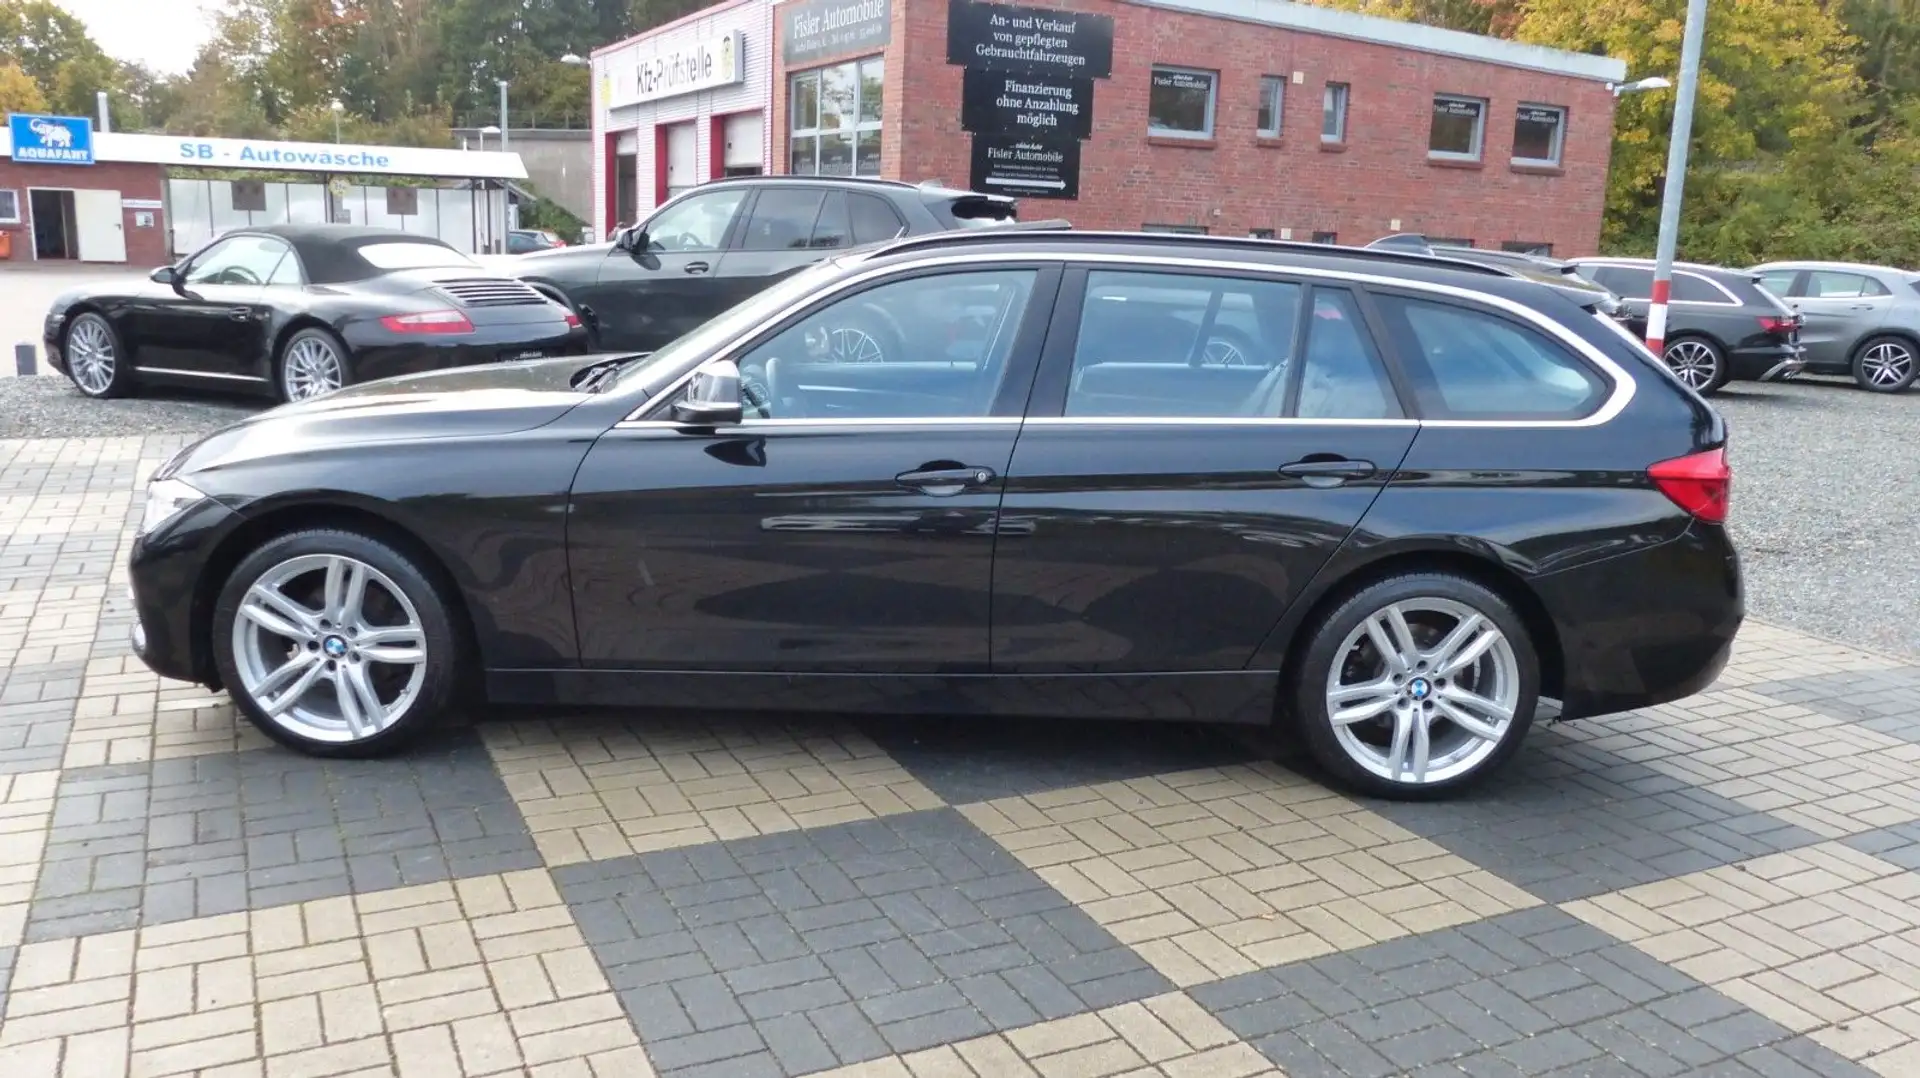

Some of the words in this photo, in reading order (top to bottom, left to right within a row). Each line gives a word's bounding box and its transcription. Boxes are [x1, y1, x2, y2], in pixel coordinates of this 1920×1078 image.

[793, 12, 820, 39] Fisler
[822, 0, 884, 32] Automobile
[990, 13, 1010, 27] An-
[1012, 16, 1033, 29] und
[1035, 18, 1077, 34] Verkauf
[993, 31, 1013, 43] von
[1015, 33, 1068, 49] gepflegten
[975, 43, 1086, 66] Gebrauchtfahrzeugen
[637, 45, 712, 95] Kfz-Prüfstelle
[1005, 79, 1072, 99] Finanzierung
[996, 94, 1022, 108] ohne
[1024, 97, 1079, 115] Anzahlung
[1016, 112, 1058, 127] möglich
[180, 143, 214, 160] SB
[239, 145, 390, 168] Autowäsche
[987, 147, 1012, 159] Fisler
[1014, 149, 1064, 163] Automobile
